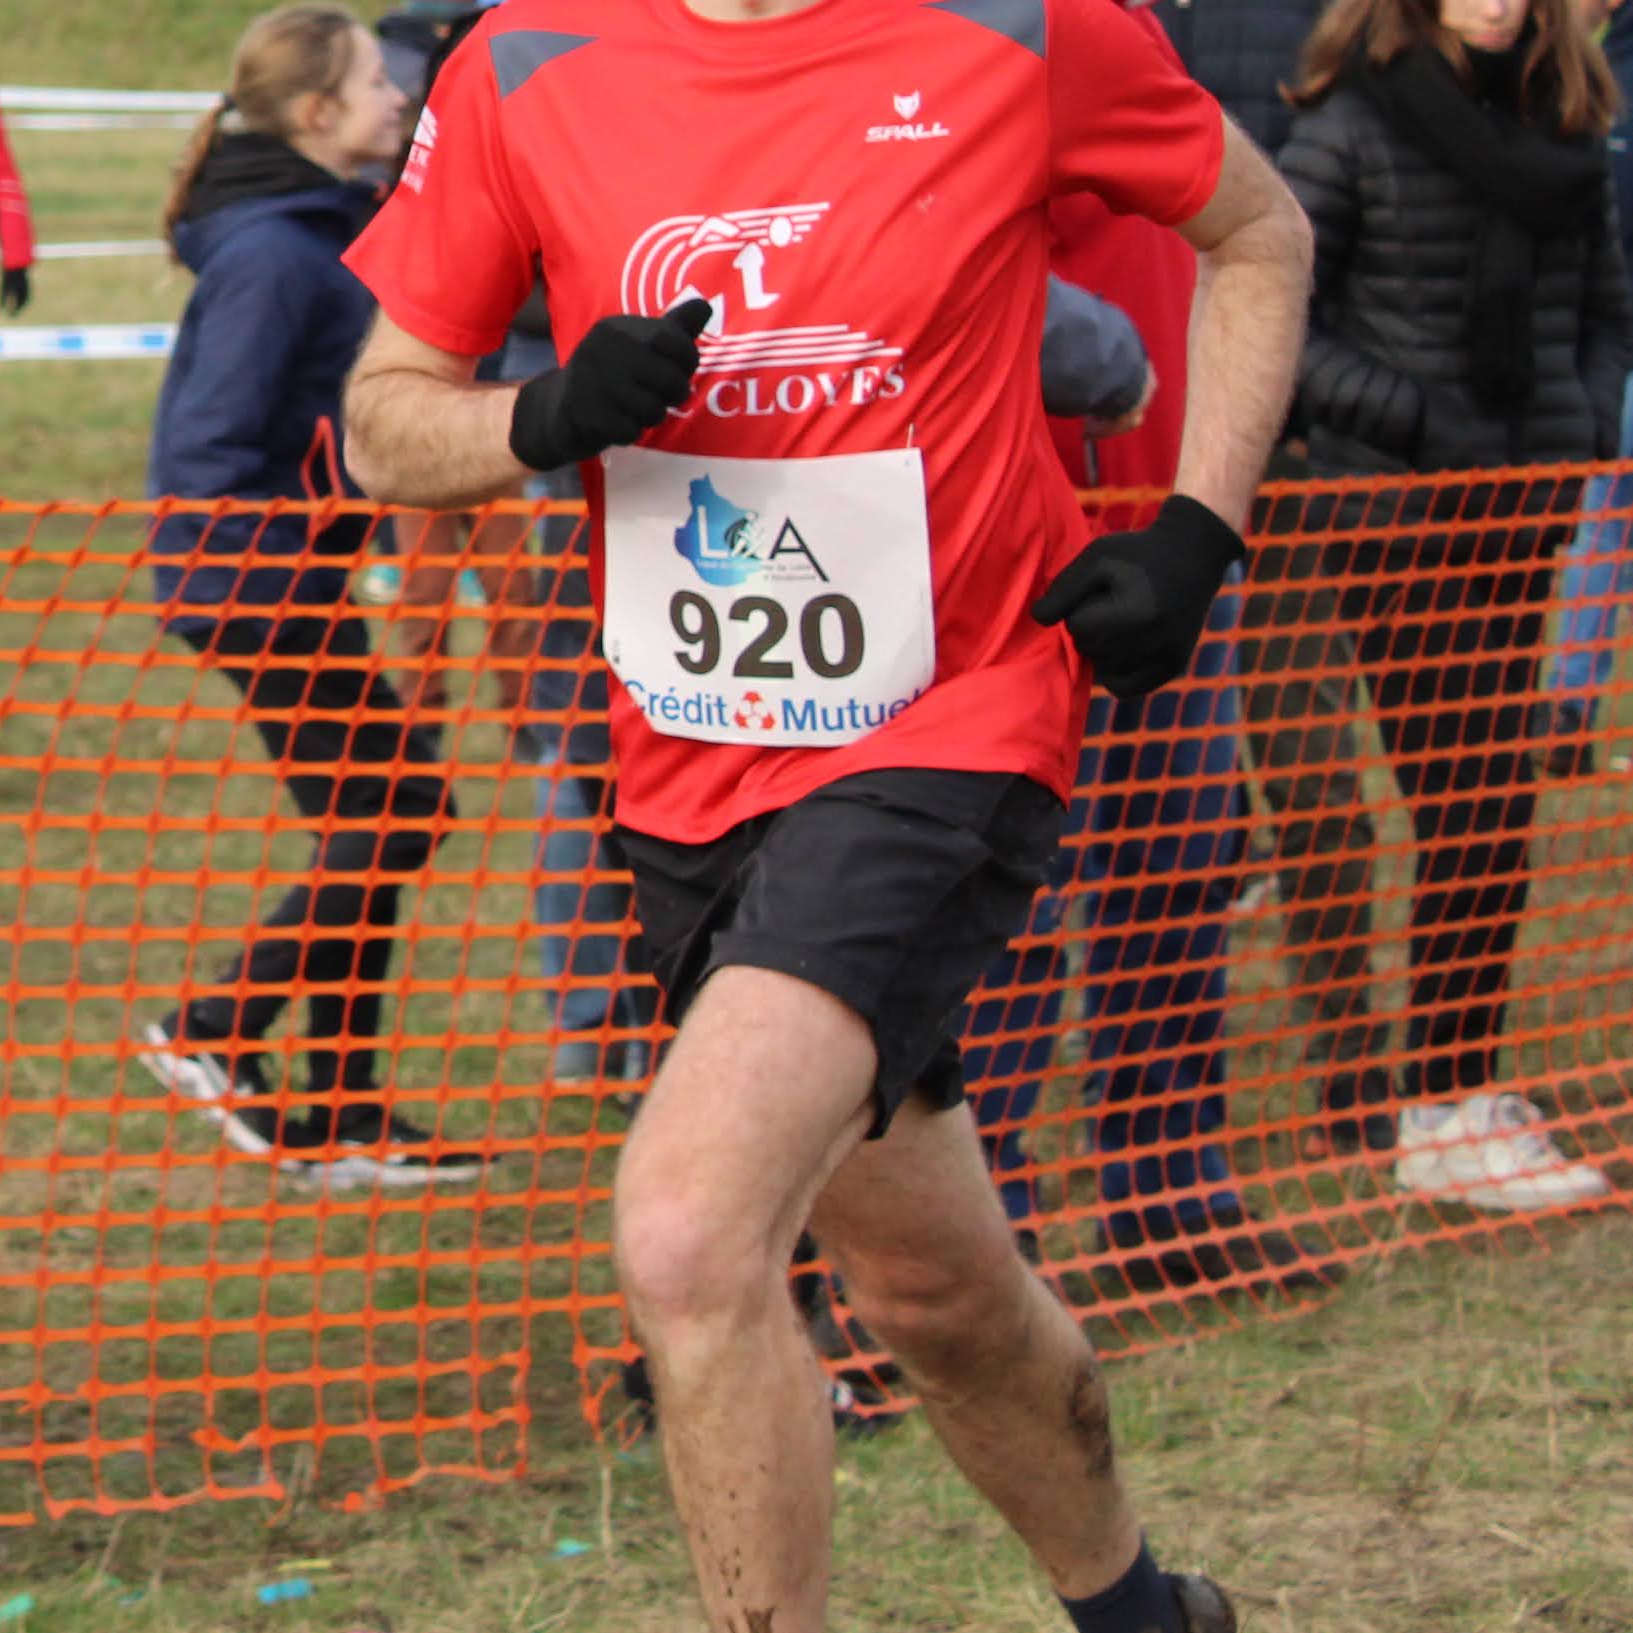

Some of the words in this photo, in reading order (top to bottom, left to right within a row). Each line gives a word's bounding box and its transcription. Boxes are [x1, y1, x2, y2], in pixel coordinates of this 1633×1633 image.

[863, 121, 950, 143] SPALL
[706, 365, 906, 418] CLOYES
[668, 589, 866, 680] 920
